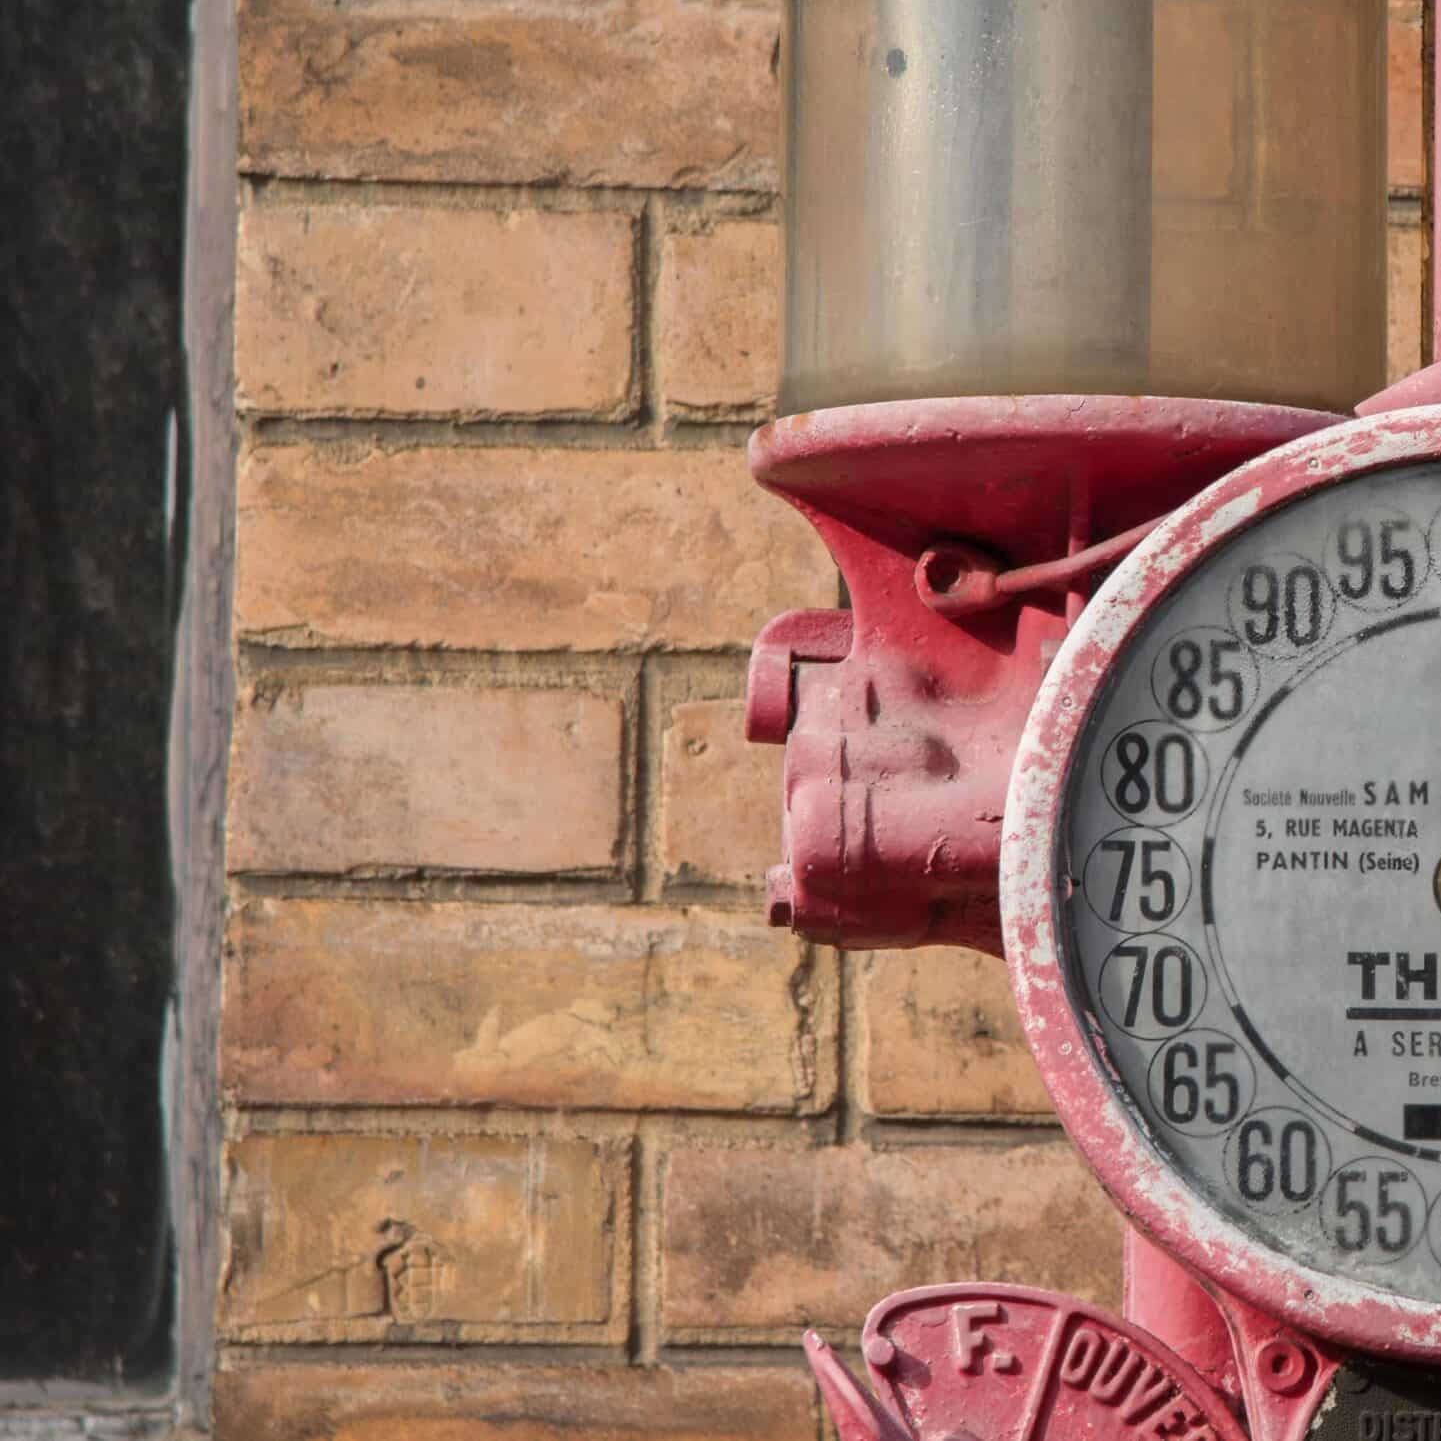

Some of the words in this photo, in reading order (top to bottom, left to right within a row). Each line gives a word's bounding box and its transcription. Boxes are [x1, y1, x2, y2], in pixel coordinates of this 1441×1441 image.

[1337, 520, 1415, 600] 95
[1242, 564, 1320, 647] 90
[1167, 639, 1244, 721] 85
[1115, 732, 1195, 814] 80
[1299, 789, 1356, 806] Nouvelle
[1256, 820, 1272, 839] 5,
[1286, 819, 1320, 837] RUE
[1333, 819, 1418, 838] MAGENTA
[1256, 851, 1348, 870] PANTIN
[1359, 852, 1420, 874] (Seine)
[1102, 840, 1175, 921] 75
[1114, 945, 1193, 1028] 70
[1163, 1042, 1240, 1125] 65
[1353, 1030, 1368, 1057] A
[1238, 1119, 1317, 1202] 60
[1335, 1171, 1412, 1253] 55
[951, 1302, 1016, 1373] F.
